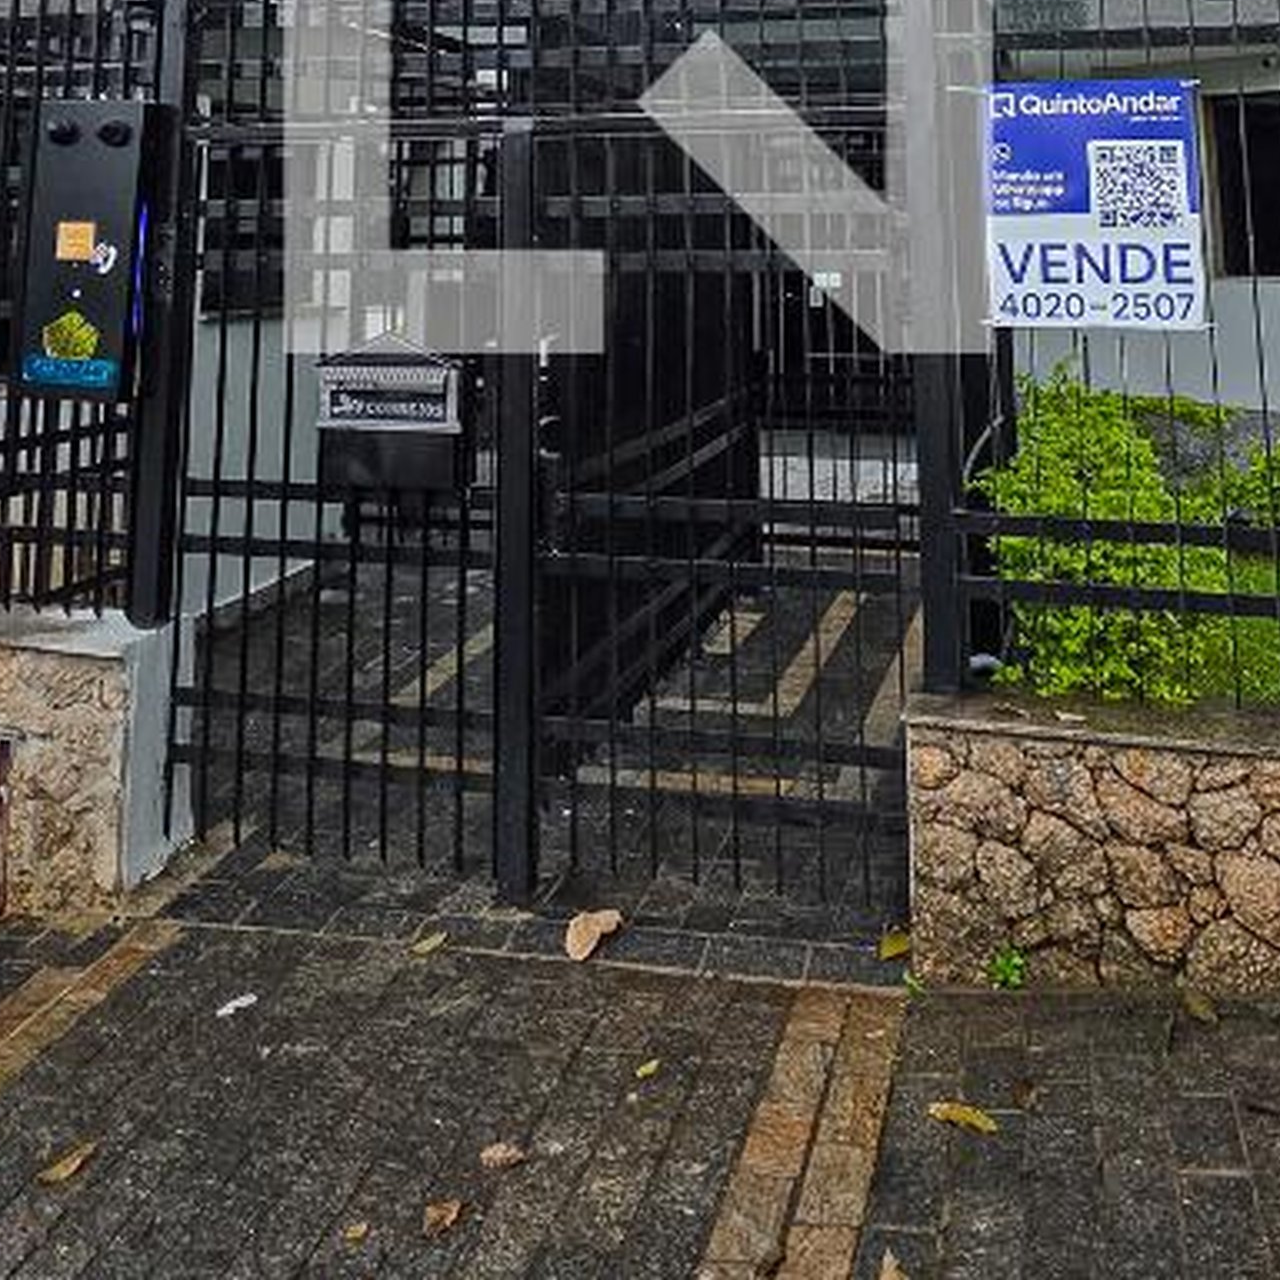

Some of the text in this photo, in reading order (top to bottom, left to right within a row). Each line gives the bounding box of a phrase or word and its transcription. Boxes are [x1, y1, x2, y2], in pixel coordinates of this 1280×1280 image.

[1019, 91, 1182, 115] QuintoAndar
[997, 242, 1195, 284] VENDE
[999, 292, 1195, 321] 4020-2507
